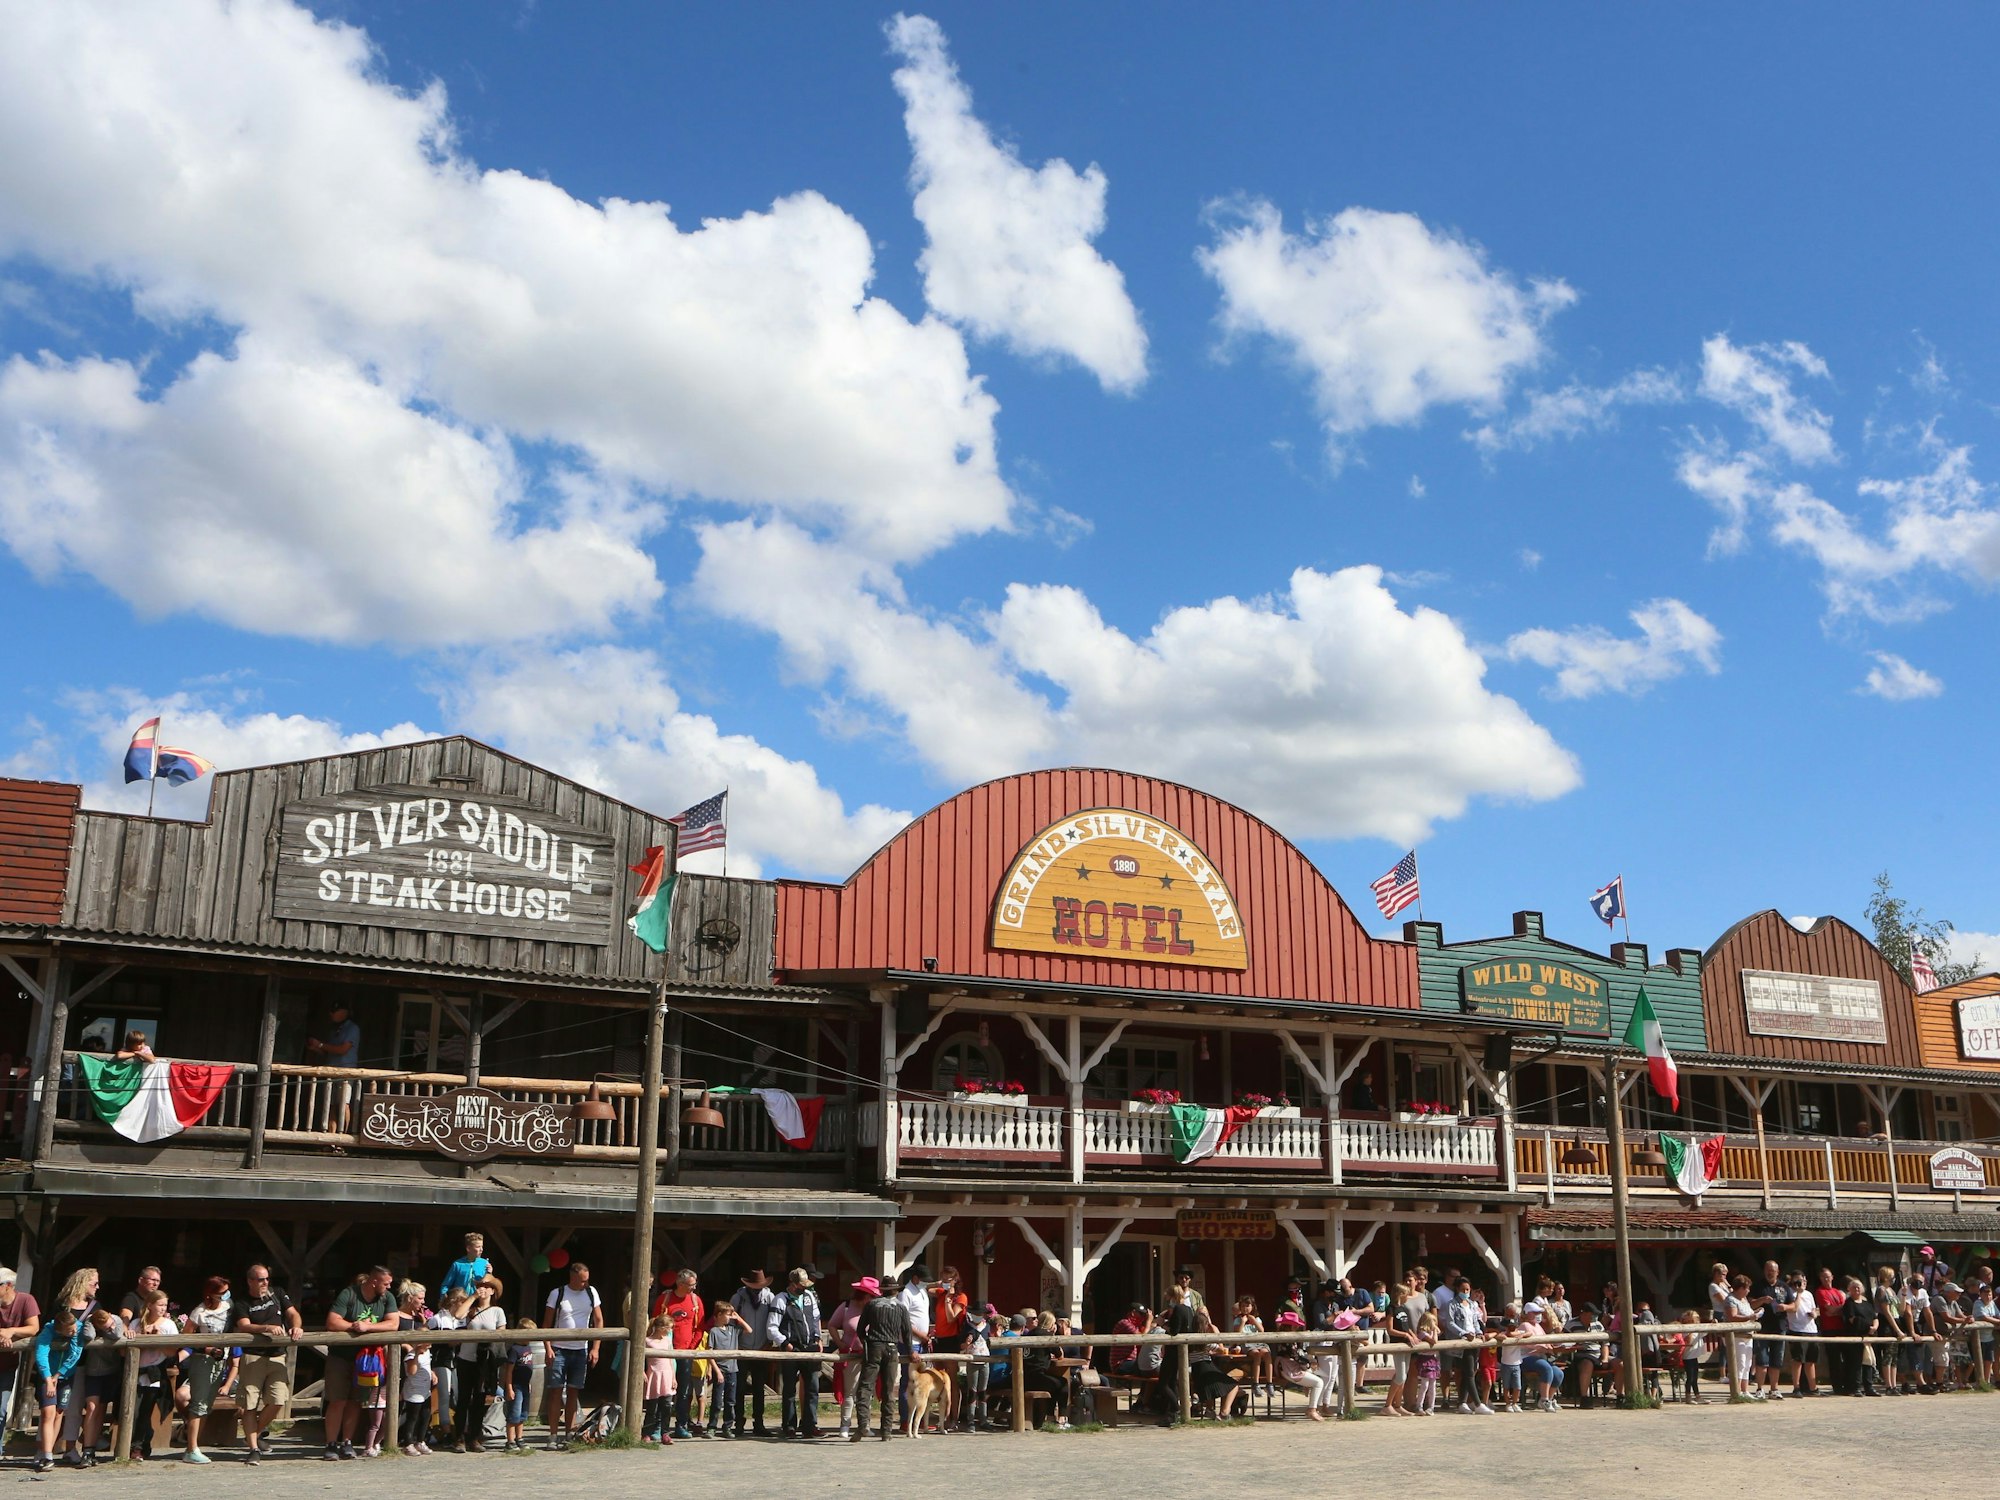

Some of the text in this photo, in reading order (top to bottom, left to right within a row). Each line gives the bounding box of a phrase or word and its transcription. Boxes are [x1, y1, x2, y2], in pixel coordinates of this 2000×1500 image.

[303, 798, 596, 894] SILVER SADDLE
[424, 848, 474, 877] 1881
[1003, 816, 1239, 937] GRAND SILVER STAR
[1113, 859, 1136, 873] 1880
[318, 869, 571, 922] STEAK HOUSE
[1053, 896, 1194, 956] HOTEL
[1472, 963, 1600, 996] WILD WEST
[1510, 997, 1571, 1026] JEWELRY
[1750, 976, 1879, 1019] GENERAL STORE
[1970, 1004, 1989, 1021] CITY
[455, 1095, 488, 1116] BEST
[363, 1100, 456, 1152] Steaks
[454, 1116, 485, 1129] IN TOWN
[487, 1104, 572, 1152] Burger
[1182, 1222, 1273, 1238] HOTEL
